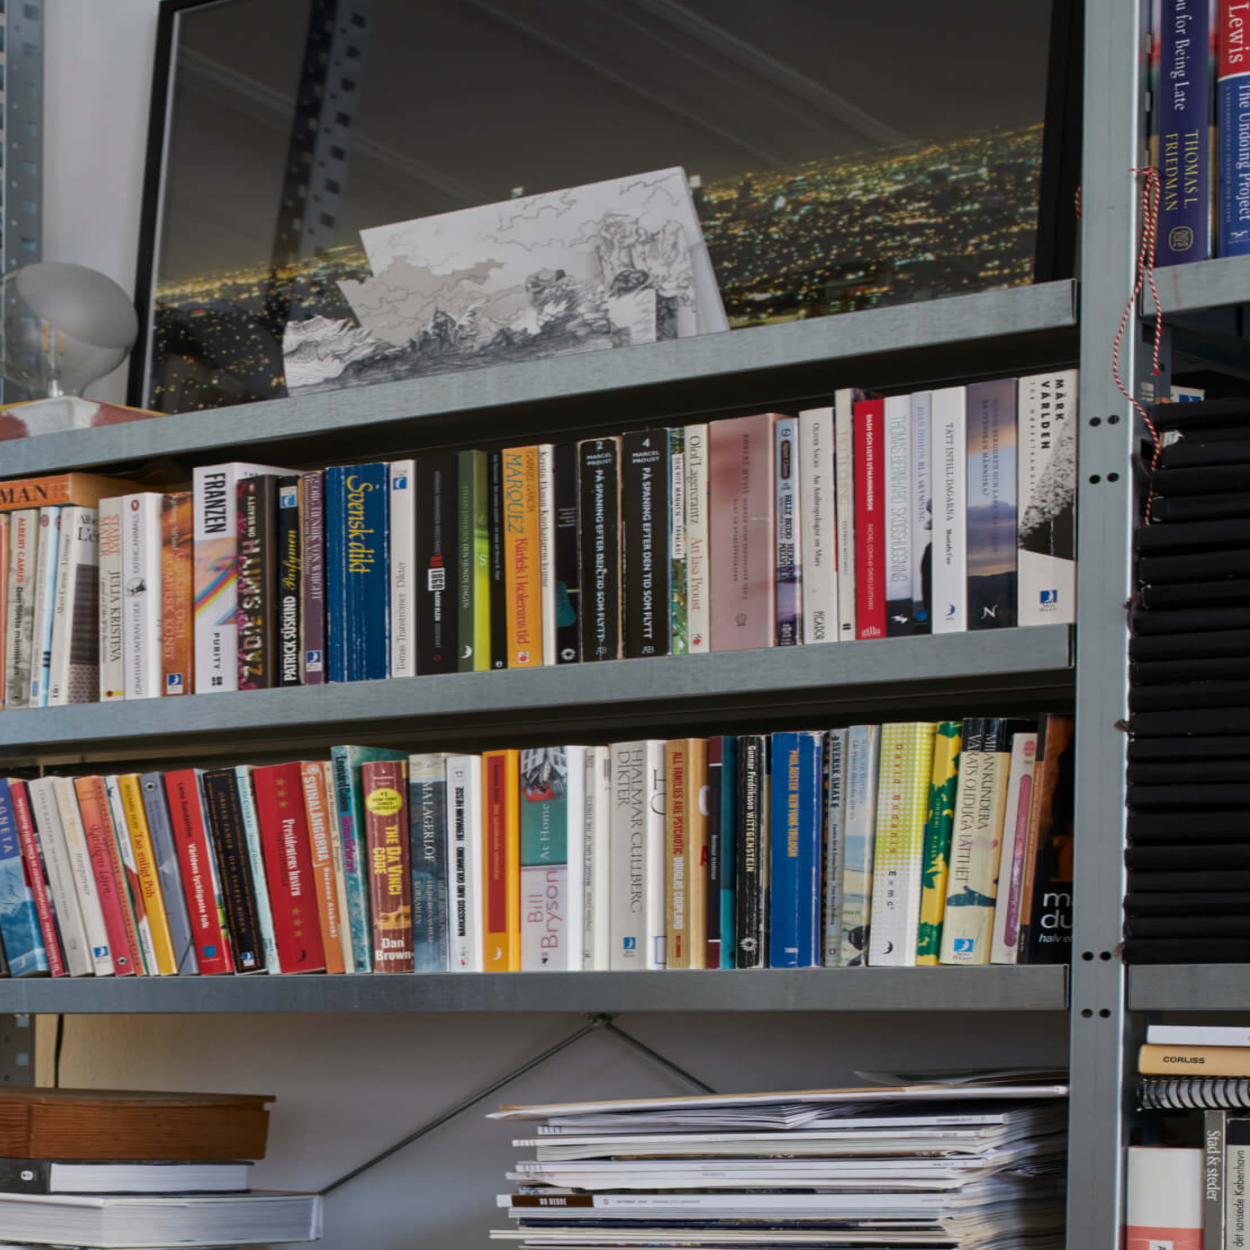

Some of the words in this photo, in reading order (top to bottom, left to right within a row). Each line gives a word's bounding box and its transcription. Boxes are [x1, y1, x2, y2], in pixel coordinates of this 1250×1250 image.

[1175, 15, 1192, 34] for
[1228, 3, 1250, 64] Lewis
[1170, 40, 1190, 79] Being
[1175, 80, 1190, 111] Late
[1238, 84, 1250, 108] The
[1236, 111, 1250, 160] Undoing
[1166, 133, 1179, 211] FRIEDMAN
[1184, 130, 1199, 193] THOMAS
[1236, 164, 1250, 220] Project
[1040, 381, 1051, 450] VÄRLDEN
[1054, 379, 1066, 421] MÄRK
[689, 436, 702, 461] Olof
[812, 423, 821, 446] OLIVER
[945, 423, 954, 446] TÄTT
[642, 467, 653, 480] PÅ
[813, 475, 822, 485] An
[204, 472, 226, 534] FRANZEN
[346, 475, 374, 540] Svensk
[642, 481, 652, 521] SPANING
[687, 462, 702, 524] Lagercrantz
[783, 494, 792, 515] BILLY
[811, 487, 822, 537] Anthropologist
[17, 517, 25, 549] ALBERT
[643, 523, 652, 551] EFTER
[784, 518, 792, 540] BUDD
[814, 538, 821, 548] on
[281, 530, 302, 591] Parfymen
[348, 541, 375, 574] dikt
[514, 538, 528, 573] Kärlek
[643, 552, 652, 570] DEN
[691, 537, 702, 554] Att
[814, 550, 823, 567] Mars
[17, 552, 25, 583] CAMUS
[643, 573, 653, 588] TID
[691, 556, 703, 575] läsa
[15, 587, 23, 602] Den
[108, 570, 121, 603] JULIA
[643, 590, 653, 610] SOM
[692, 577, 704, 611] Proust
[14, 604, 24, 629] första
[281, 595, 297, 639] SÜSKIND
[516, 582, 530, 628] kolerans
[109, 608, 121, 662] KRISTEVA
[517, 630, 531, 645] tid
[643, 612, 653, 639] FLYTT
[813, 611, 825, 640] PICADOR
[213, 632, 221, 669] PURITY
[283, 641, 298, 681] PATRICK
[672, 752, 682, 766] ALL
[746, 745, 756, 770] Gunnar
[616, 750, 630, 807] DIKTER
[629, 749, 644, 829] HJALMAR
[672, 767, 683, 800] FAMILIES
[746, 771, 756, 810] Fredriksson
[303, 777, 328, 862] SVINALÄNGORNA
[539, 803, 552, 842] Home
[672, 801, 683, 814] ARE
[133, 832, 144, 850] Tao
[282, 819, 297, 870] Presidentens
[385, 824, 399, 844] THE
[423, 801, 437, 864] LAGERLÖF
[672, 816, 683, 855] PSYCHOTIC
[745, 812, 755, 872] WITTGENSTEIN
[136, 852, 151, 878] enligt
[187, 843, 200, 874] Världens
[373, 847, 387, 875] CODE
[387, 847, 402, 863] DA
[539, 847, 550, 860] At
[287, 870, 301, 897] hustru
[388, 866, 403, 896] VINCI
[629, 832, 644, 914] GULLBERG
[672, 856, 683, 890] DOUGLAS
[144, 880, 156, 898] Puh
[190, 875, 206, 914] lyckligaste
[199, 915, 209, 929] folk
[526, 894, 543, 923] Bill
[539, 870, 563, 949] Bryson
[673, 891, 683, 930] COUPLAND
[375, 950, 413, 961] Brown
[381, 938, 405, 948] Dan
[1162, 1056, 1205, 1064] CORLISS
[1206, 1130, 1220, 1155] Stad
[1207, 1156, 1219, 1165] &
[1234, 1150, 1247, 1196] København
[1207, 1167, 1220, 1201] steder
[1234, 1199, 1244, 1233] sansede
[1233, 1235, 1245, 1247] det
